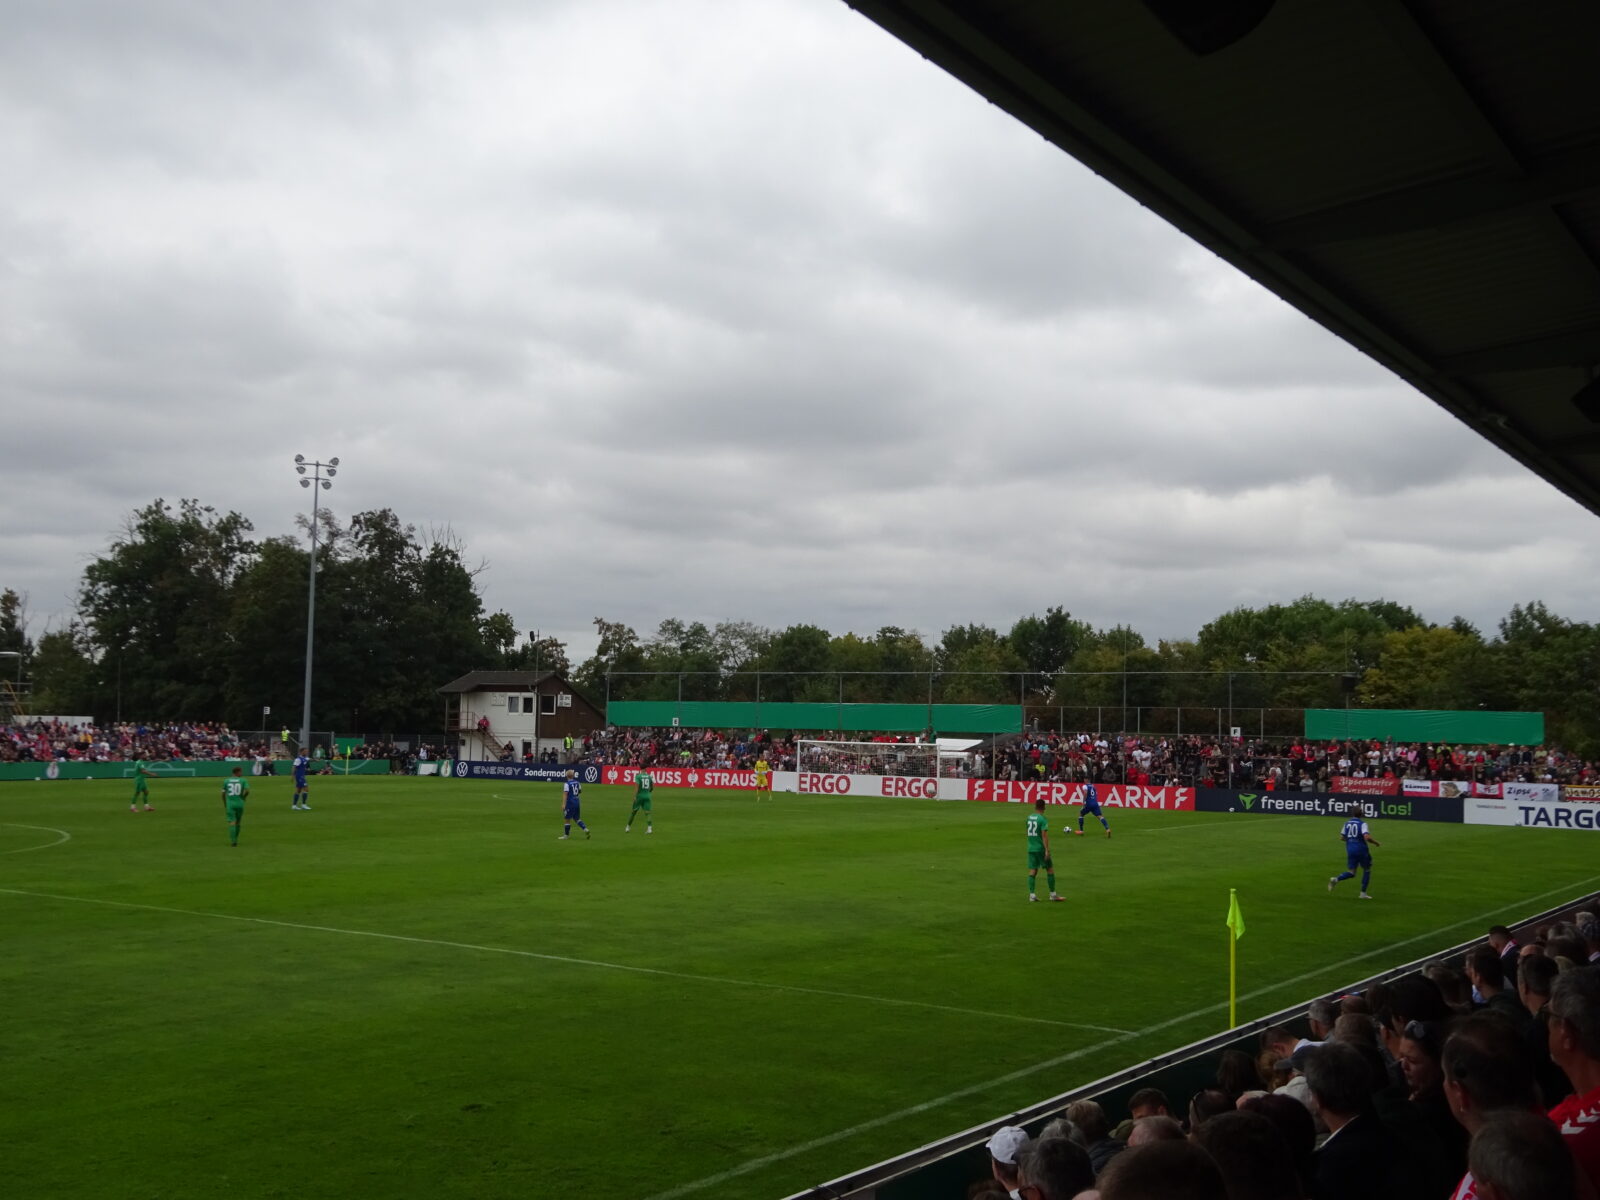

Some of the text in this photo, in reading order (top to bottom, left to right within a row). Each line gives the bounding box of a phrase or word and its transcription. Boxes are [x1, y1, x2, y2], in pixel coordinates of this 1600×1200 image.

[473, 765, 580, 779] ENERGY Sondermode
[623, 769, 682, 785] STAUSS
[704, 771, 759, 787] STRAUS
[227, 783, 242, 796] 30
[571, 784, 579, 796] 16
[641, 778, 650, 790] 19
[799, 773, 851, 794] ERGO
[882, 776, 938, 798] ERGO
[992, 780, 1165, 809] FLYERAARM
[1261, 796, 1326, 815] freenet,
[1380, 800, 1412, 816] los!
[1519, 806, 1600, 829] TARG
[1027, 821, 1038, 836] 22
[1346, 824, 1358, 838] 20
